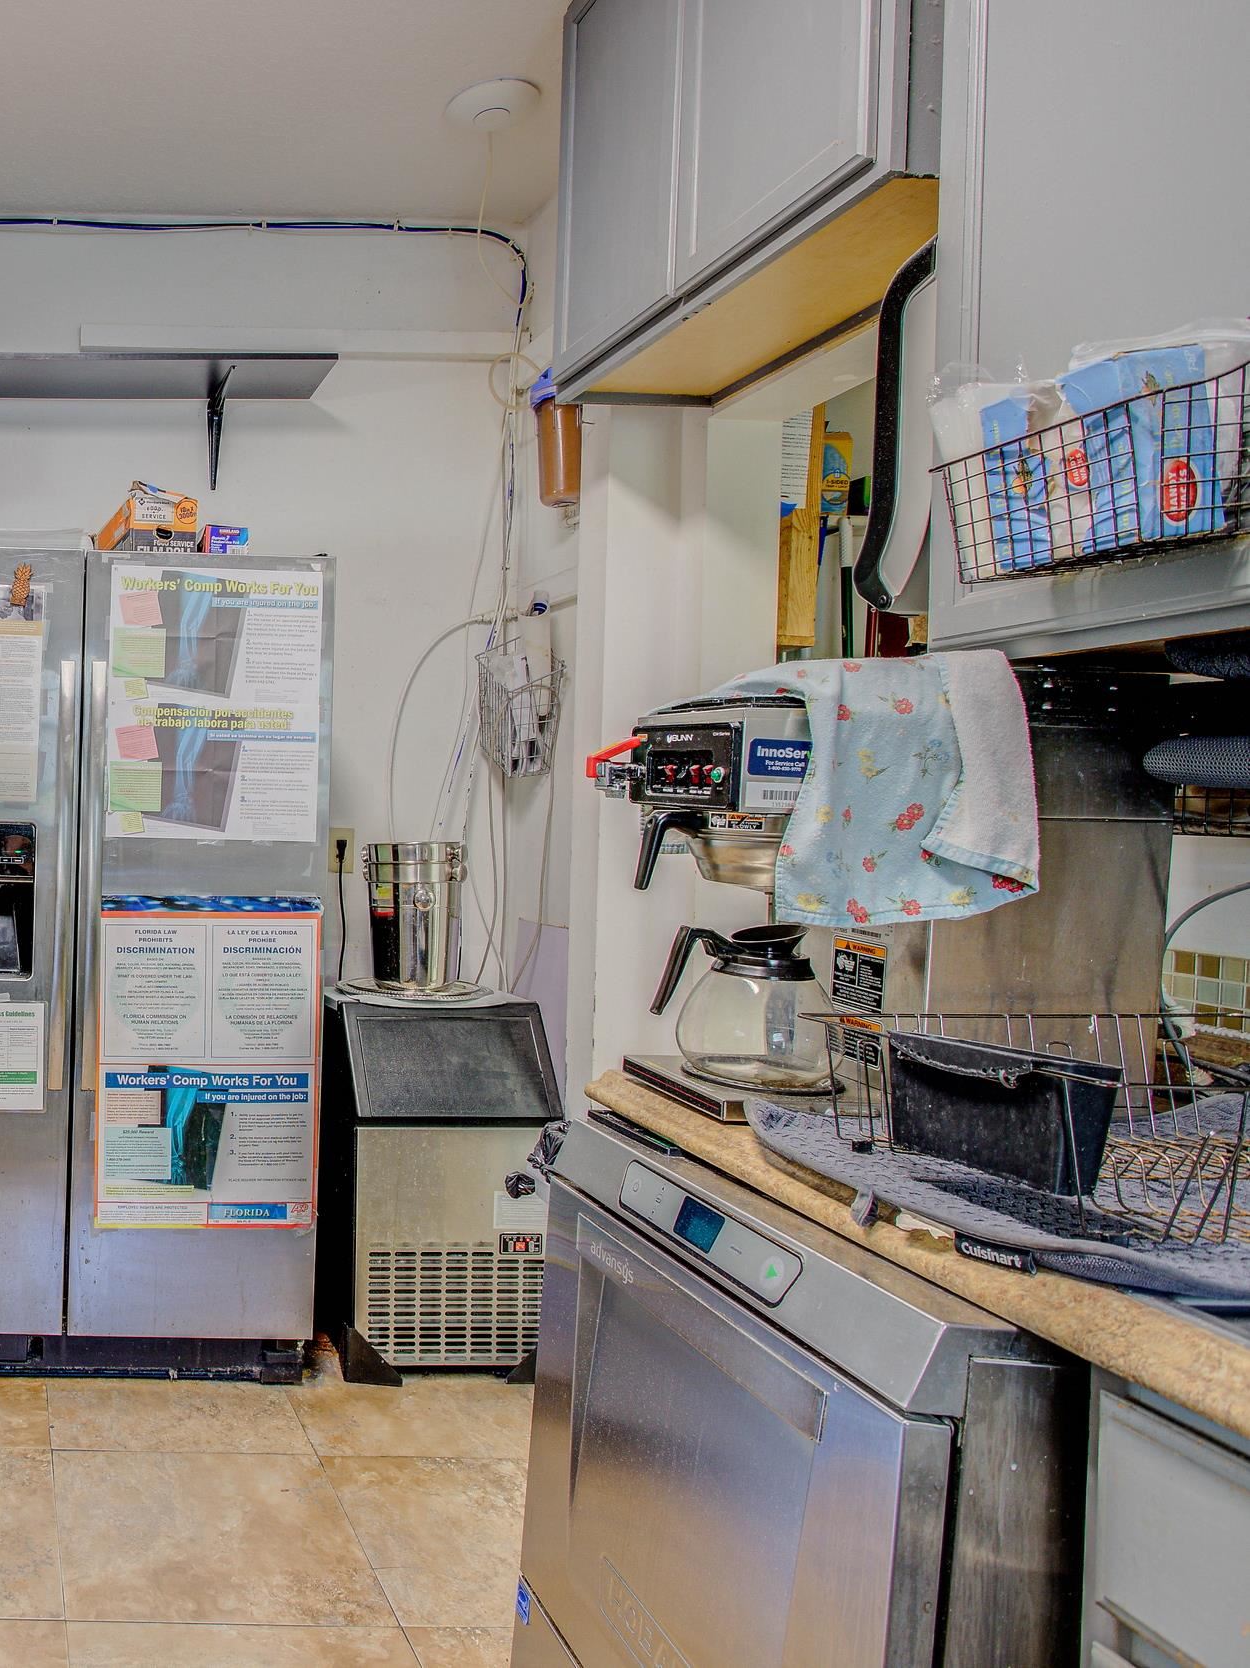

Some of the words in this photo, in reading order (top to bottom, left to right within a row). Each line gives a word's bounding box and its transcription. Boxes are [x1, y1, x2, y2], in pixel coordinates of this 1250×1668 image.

[1068, 456, 1080, 483] HANDY
[1076, 452, 1088, 482] WACKS
[121, 576, 181, 591] Workers'
[185, 579, 222, 594] Comp
[226, 580, 266, 594] Works
[270, 581, 293, 594] For
[294, 582, 318, 596] You
[250, 600, 276, 608] injured
[301, 600, 316, 608] job:
[133, 705, 212, 720] Compensación
[153, 718, 191, 729] trabajo
[194, 717, 228, 728] labora
[230, 720, 254, 730] para
[223, 945, 302, 954] DISCRIMINACIÓN
[852, 944, 876, 954] WARNING
[845, 1017, 871, 1029] WARNING
[117, 1075, 170, 1086] Workers'
[172, 1075, 208, 1087] Comp
[211, 1076, 249, 1086] Works
[252, 1076, 272, 1086] For
[274, 1076, 297, 1086] You
[241, 1093, 267, 1101] injured
[292, 1093, 307, 1102] job:
[224, 1208, 270, 1218] FLORIDA
[961, 1241, 1022, 1268] Cuisinart
